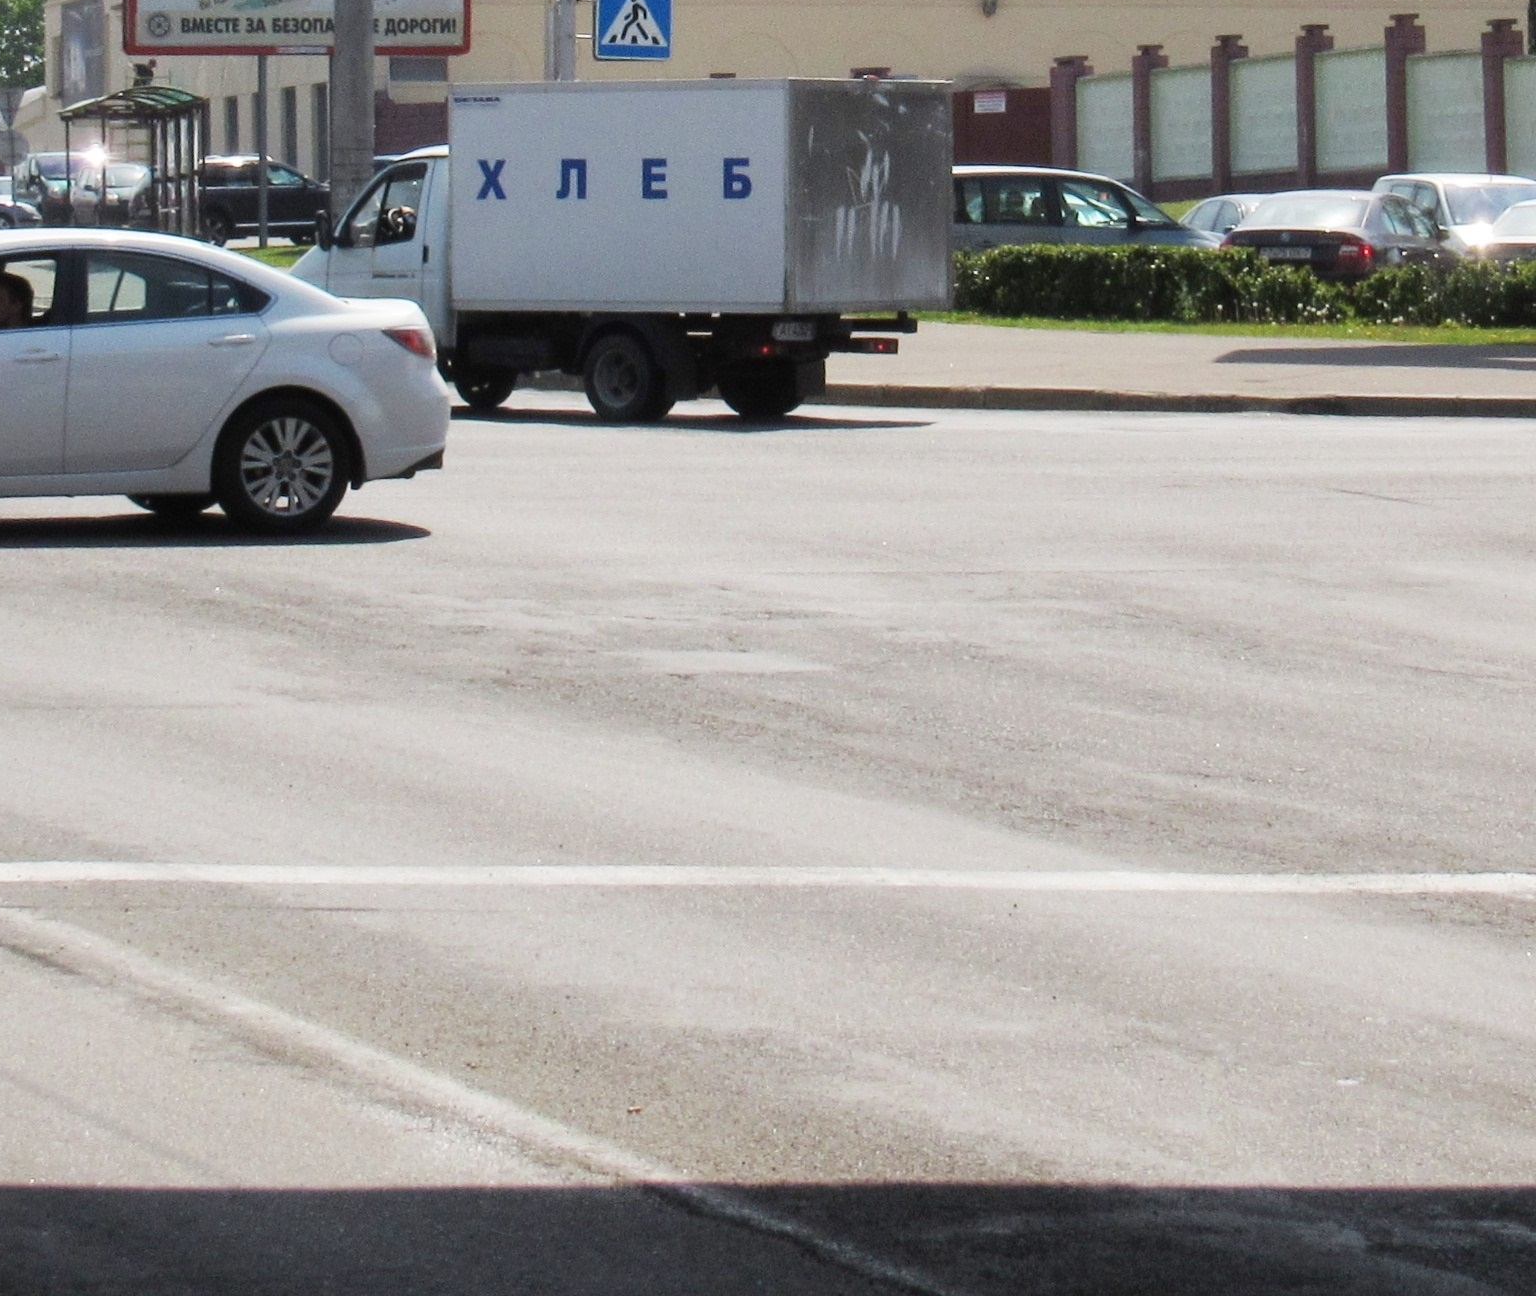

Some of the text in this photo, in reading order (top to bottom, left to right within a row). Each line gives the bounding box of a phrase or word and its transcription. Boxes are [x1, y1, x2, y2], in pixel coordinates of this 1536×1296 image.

[180, 17, 457, 36] ВМЕСТЕ ЗА БЕЗОПАЕ ДОРОГИ!
[477, 158, 754, 200] ХЛЕБ
